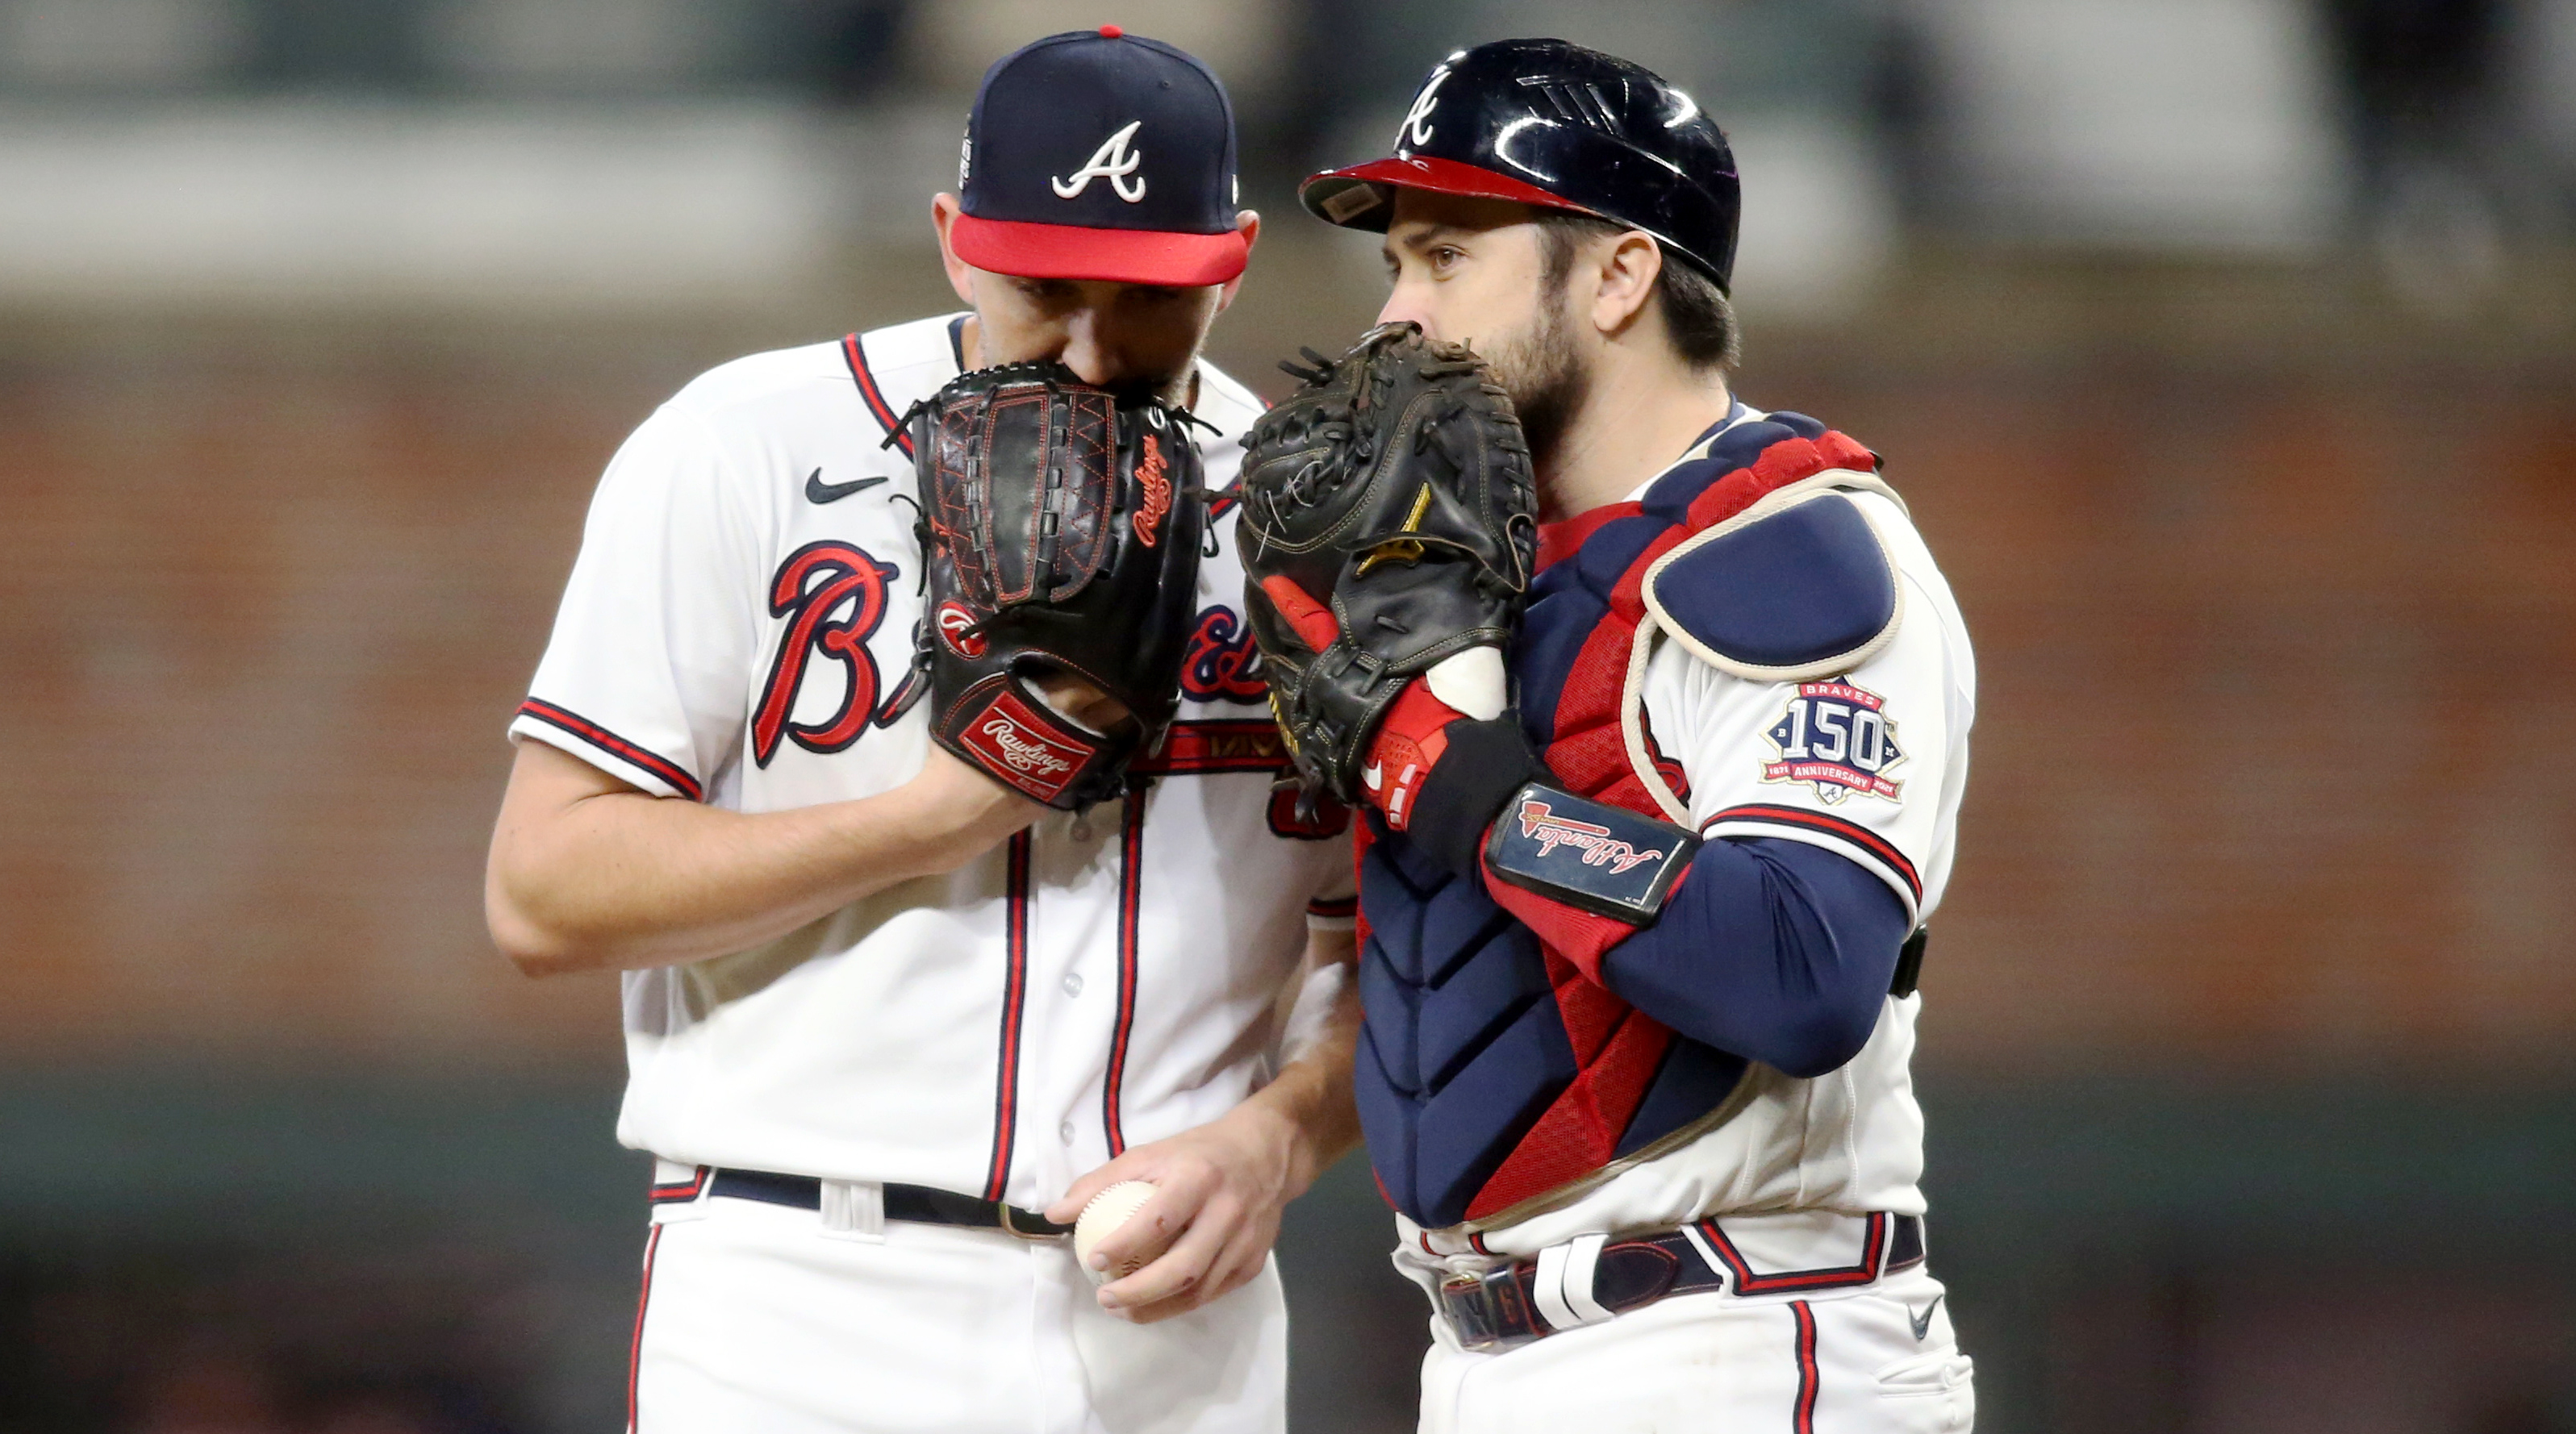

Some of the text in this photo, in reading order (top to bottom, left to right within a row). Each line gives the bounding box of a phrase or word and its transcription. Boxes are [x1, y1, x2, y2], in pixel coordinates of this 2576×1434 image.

[1051, 120, 1146, 203] A
[1806, 685, 1876, 706] BRAVES
[982, 719, 1071, 776] Rawlings
[1777, 727, 1787, 737] B
[1782, 698, 1886, 772] 150
[1768, 765, 1894, 794] 1871 ANNIVERSARY 2021
[1534, 826, 1664, 875] Atlanta
